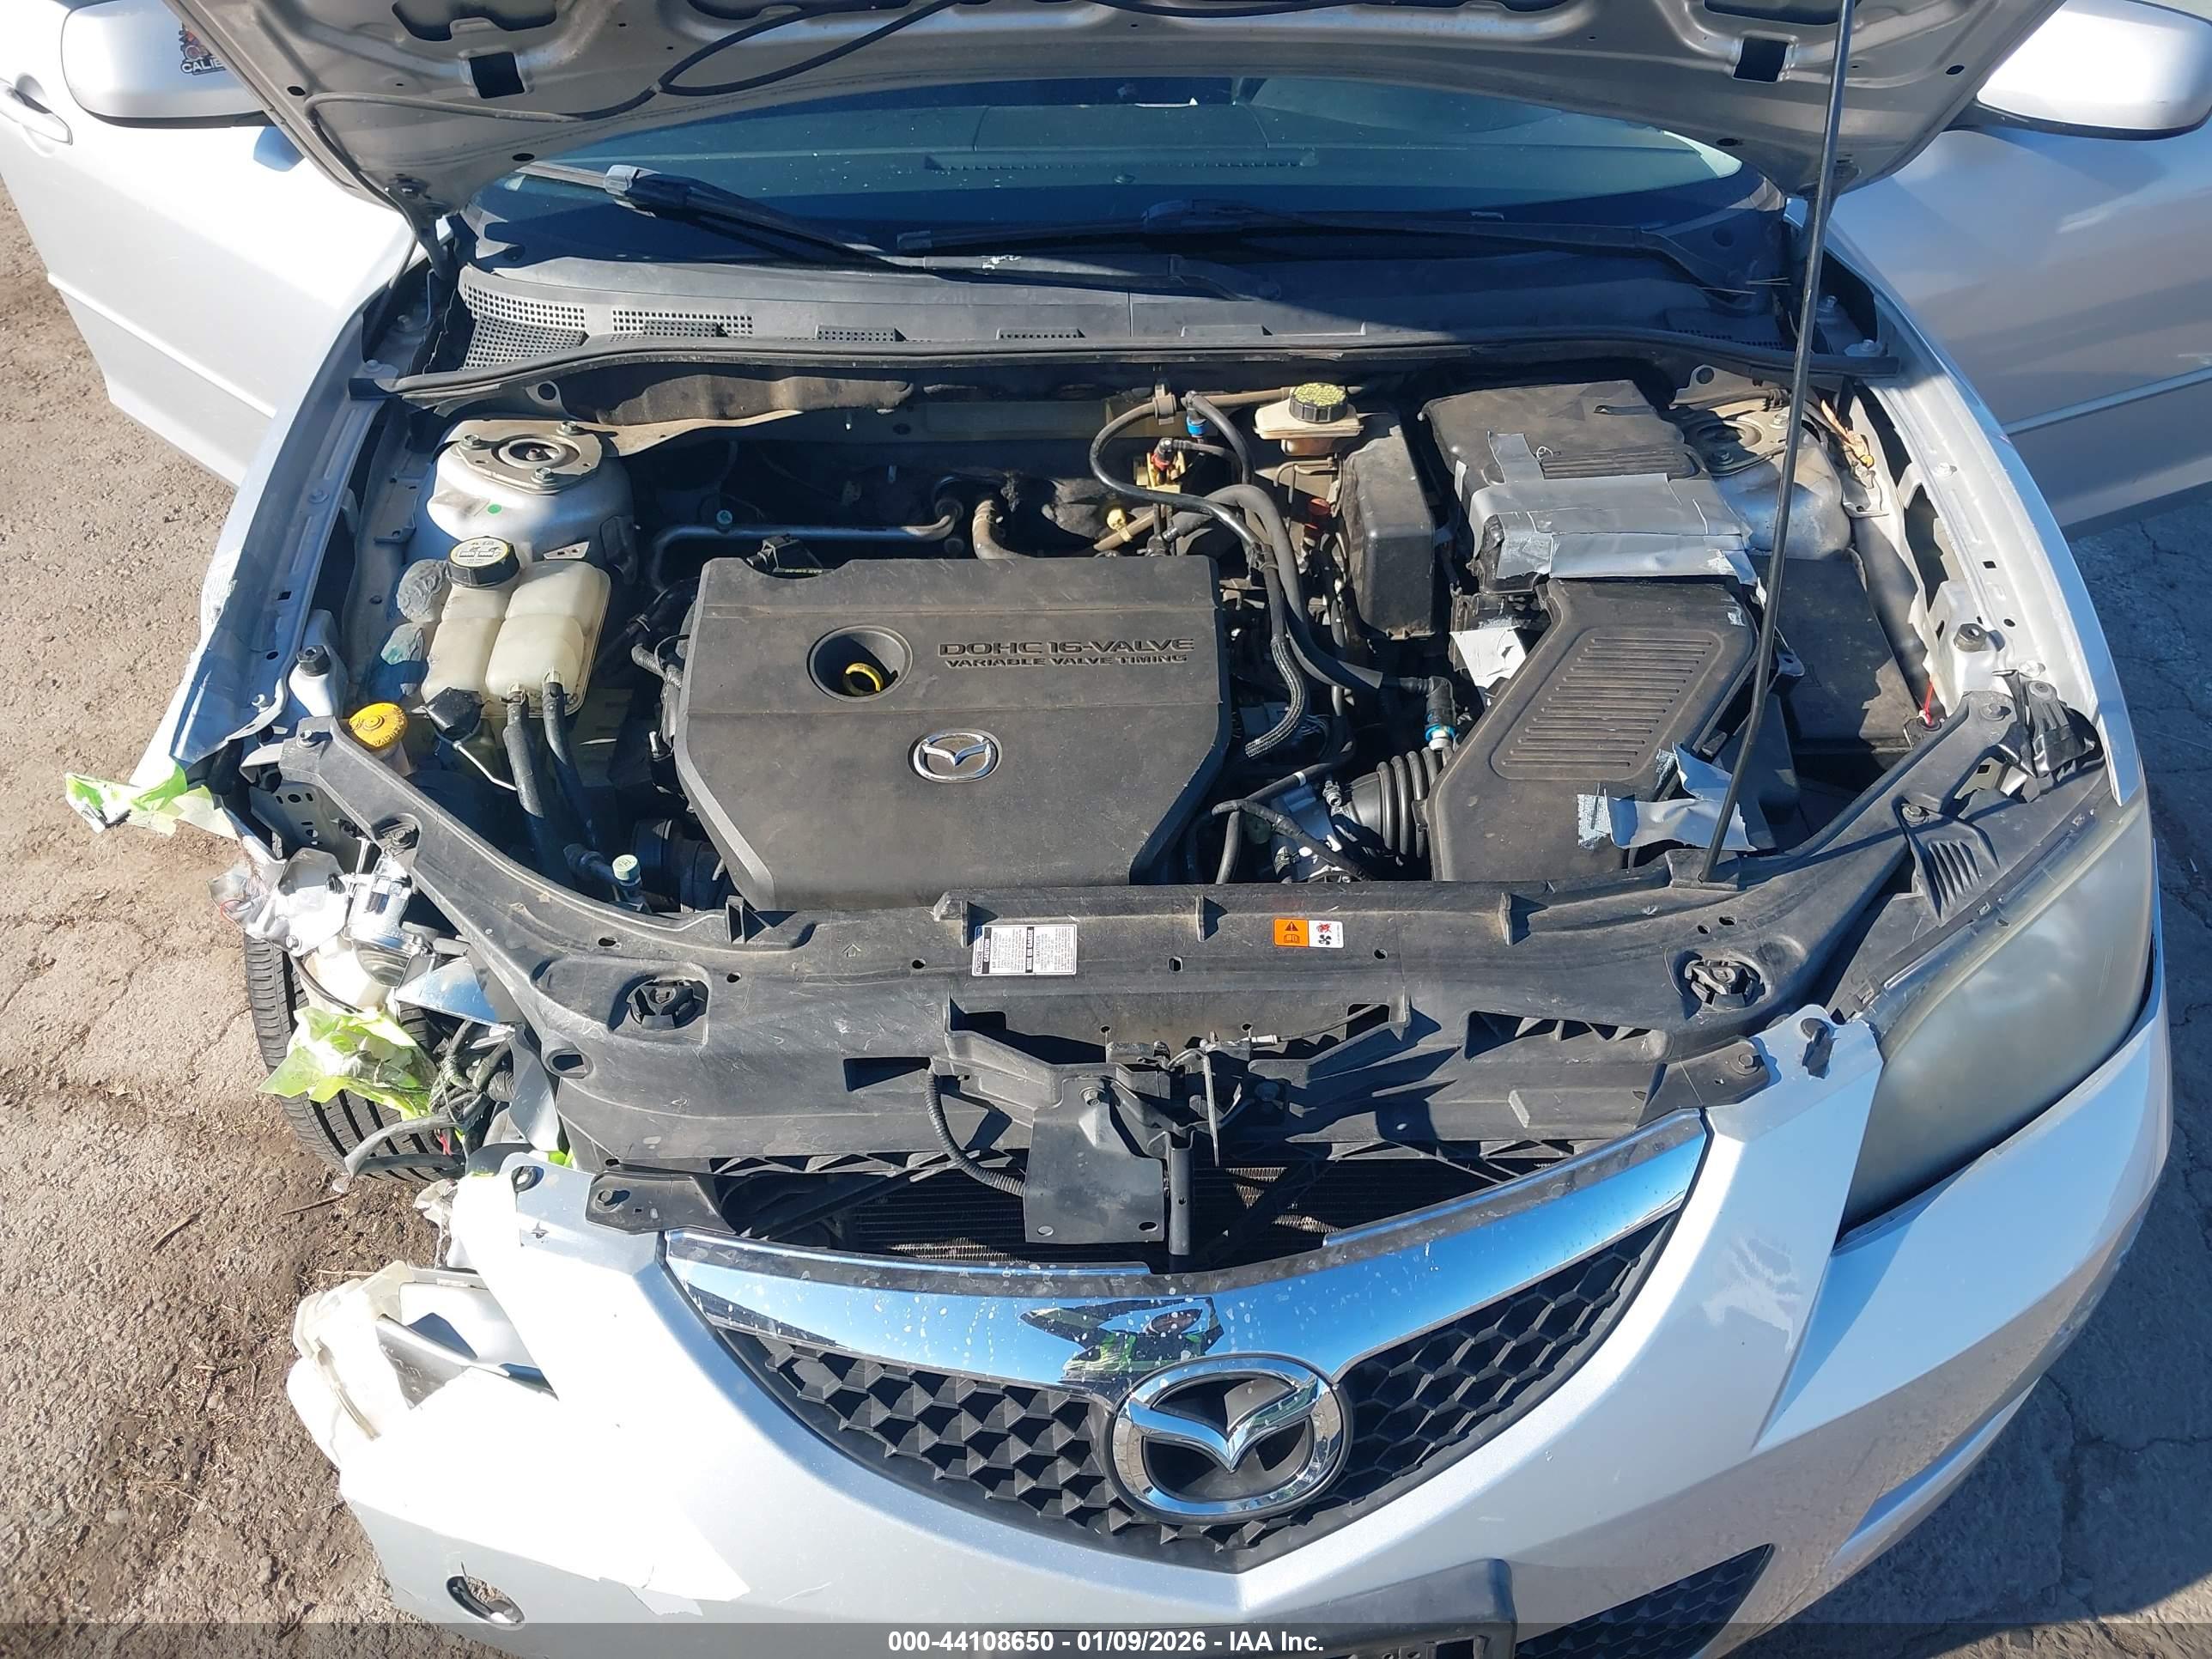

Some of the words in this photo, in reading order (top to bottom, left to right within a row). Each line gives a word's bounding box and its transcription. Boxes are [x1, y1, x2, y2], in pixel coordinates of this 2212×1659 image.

[938, 641, 1043, 657] DOHC
[1047, 637, 1196, 654] 16-VALVE
[945, 657, 1047, 668] VARIABLE
[1050, 656, 1114, 666] VALVE
[1117, 653, 1189, 665] TIMING
